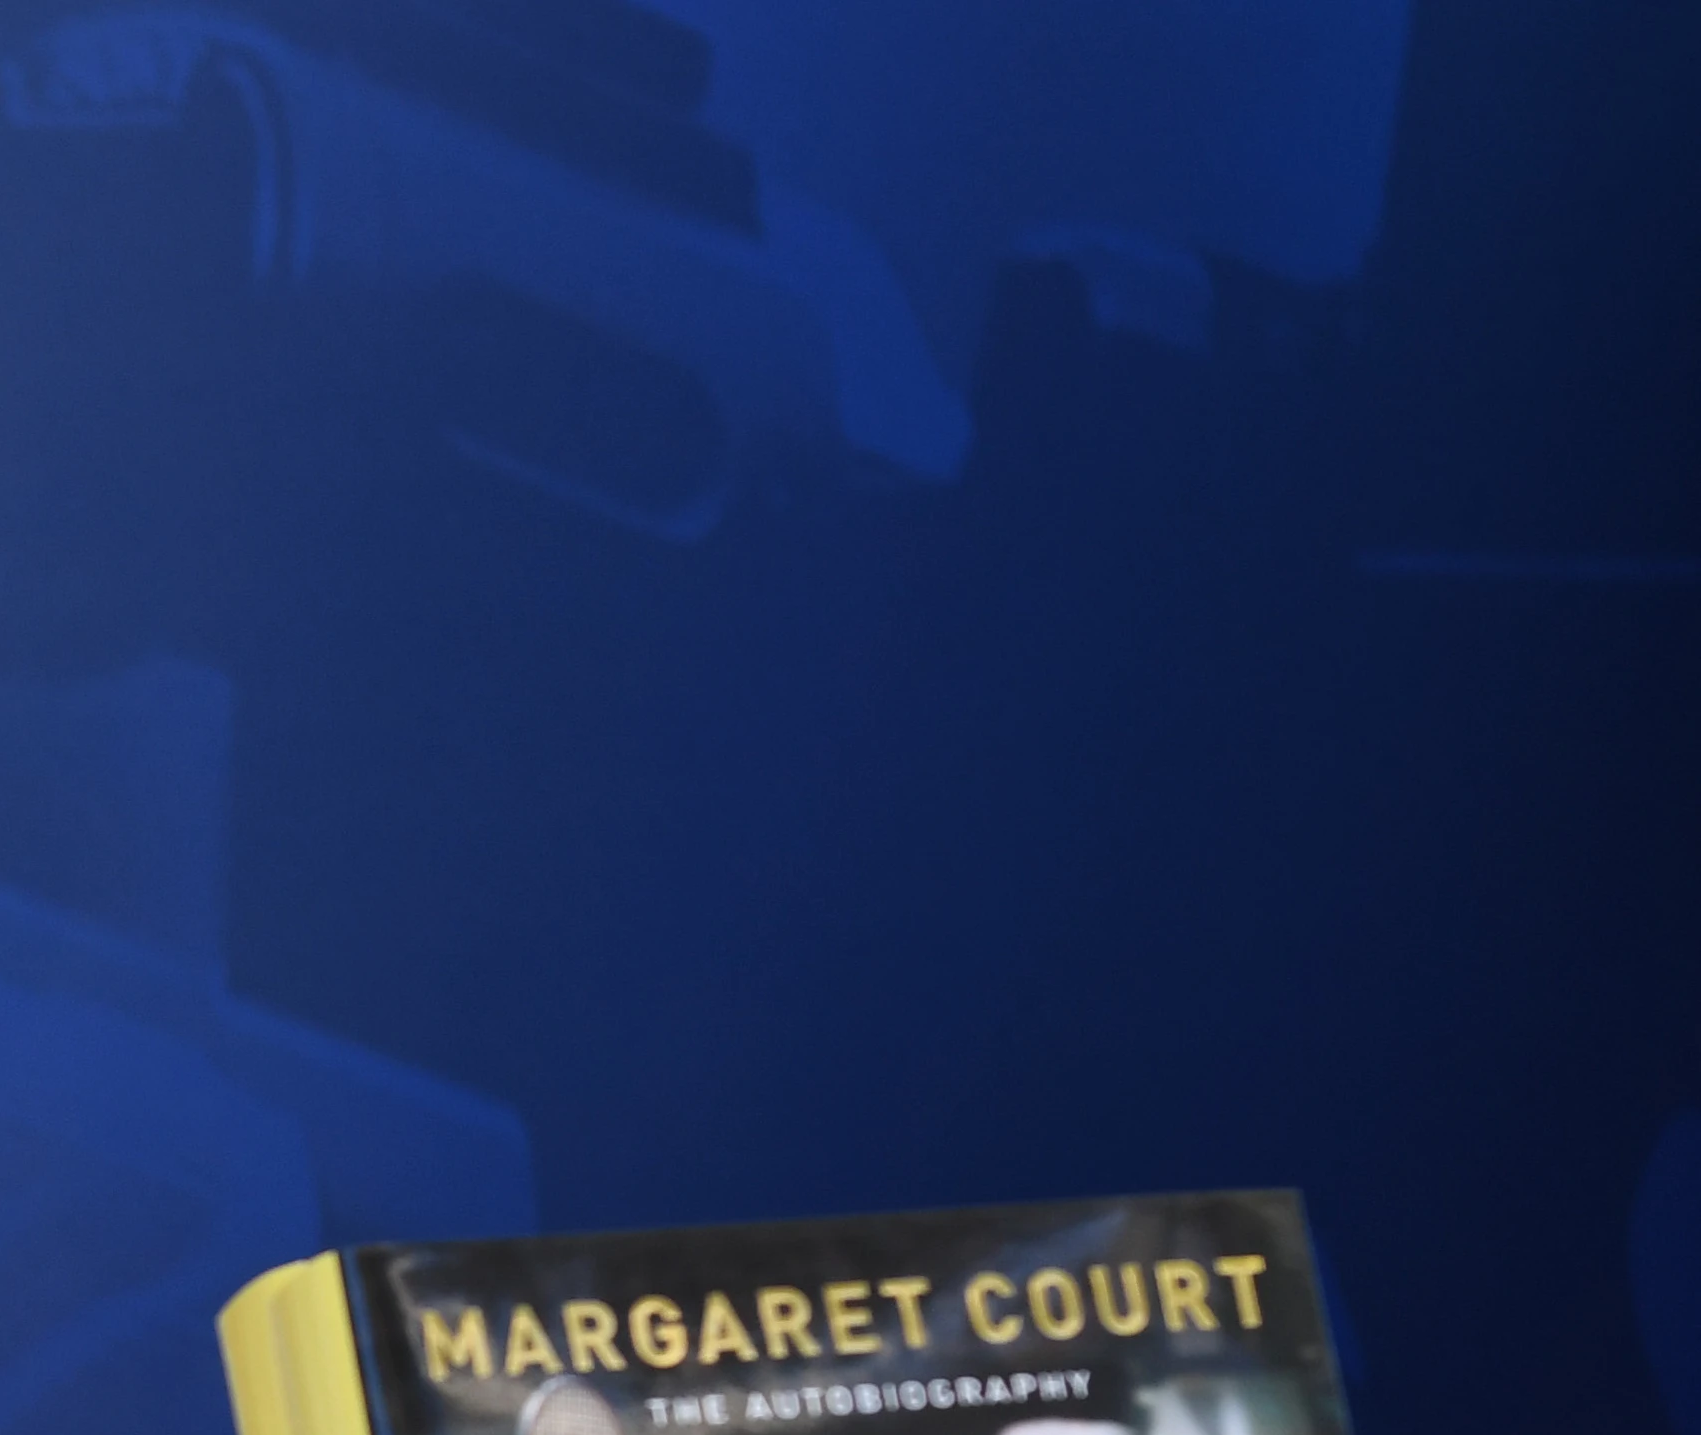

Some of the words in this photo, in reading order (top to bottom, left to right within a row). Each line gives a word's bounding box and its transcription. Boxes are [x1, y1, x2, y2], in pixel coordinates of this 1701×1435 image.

[421, 1276, 933, 1383] MARGARET
[964, 1255, 1267, 1346] COURT
[647, 1394, 729, 1428] THE
[746, 1369, 1091, 1420] AUTOBIOGRAPHY
